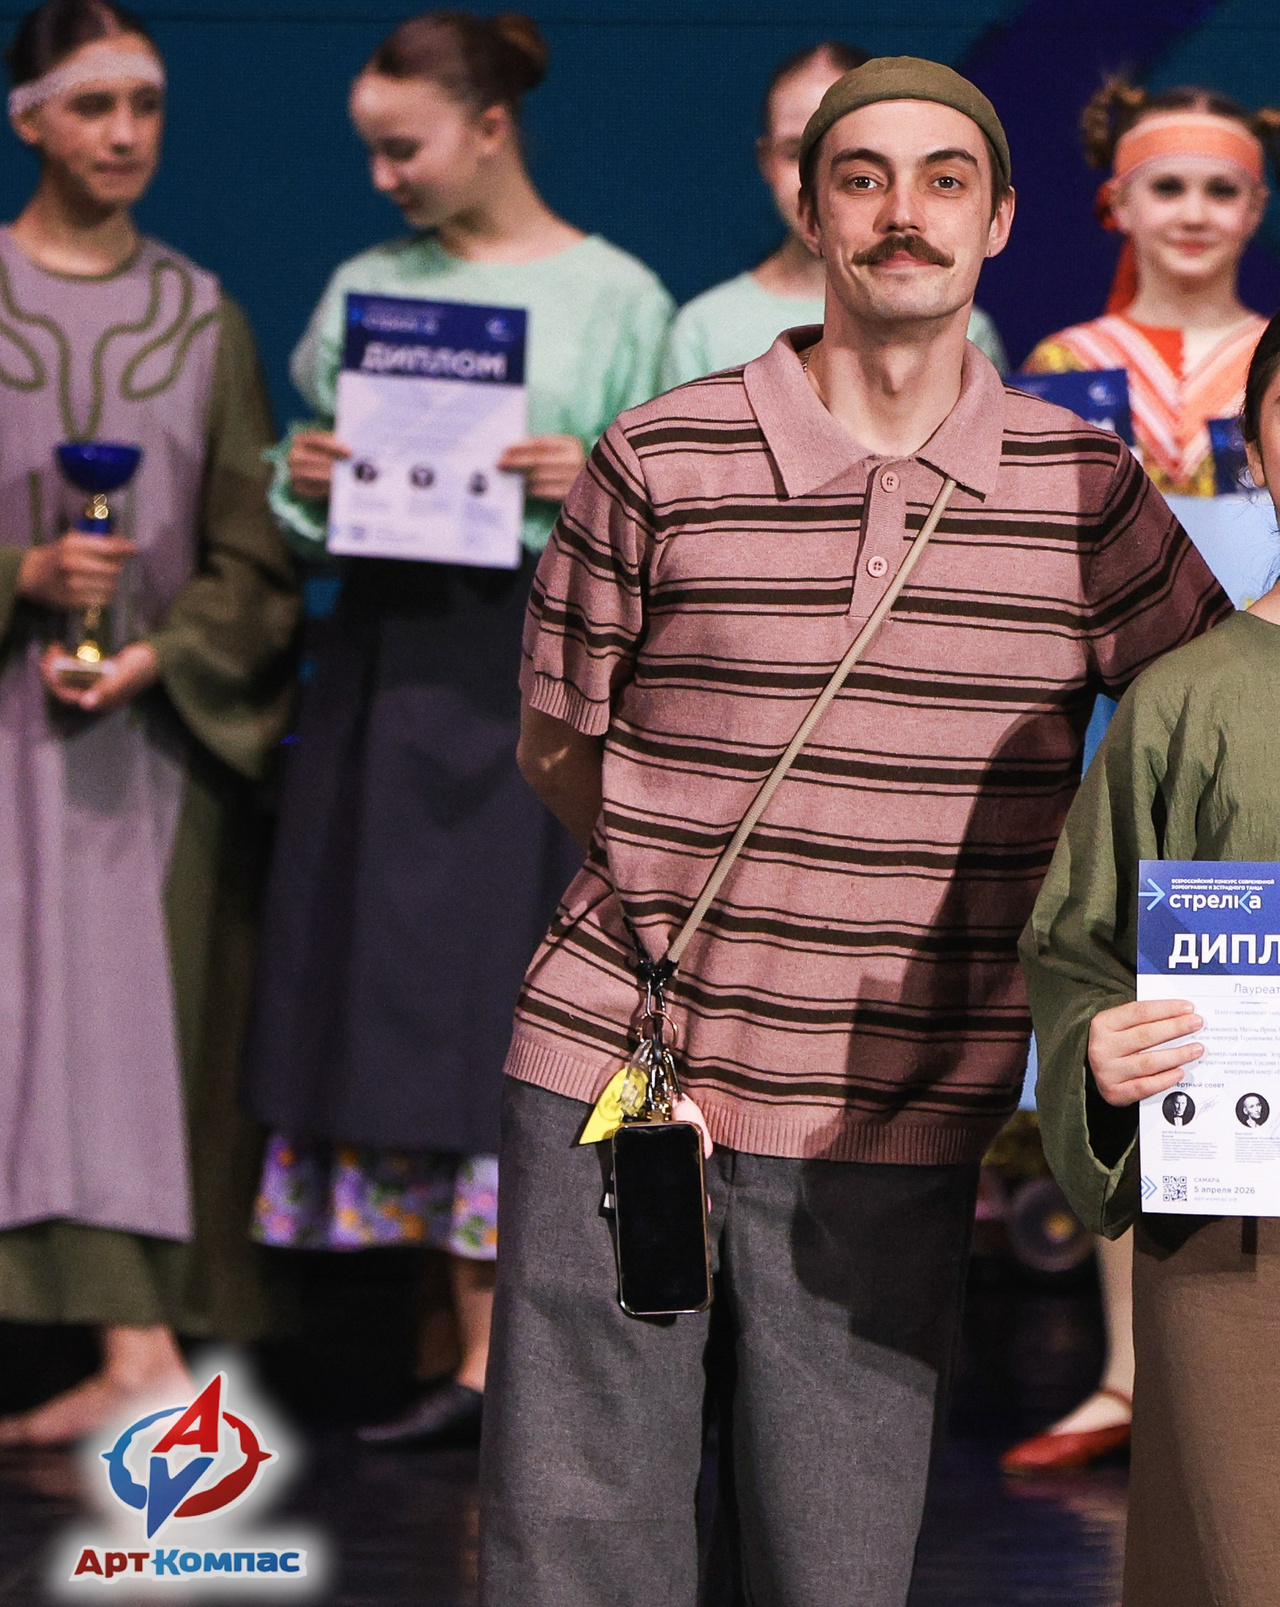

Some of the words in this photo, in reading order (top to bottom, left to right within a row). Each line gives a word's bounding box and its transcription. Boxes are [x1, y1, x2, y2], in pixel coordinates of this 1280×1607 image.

[360, 341, 508, 380] ДИПЛОМ
[1169, 890, 1262, 915] стрелка
[1233, 983, 1280, 996] Лауреат
[1201, 1187, 1232, 1195] апреля
